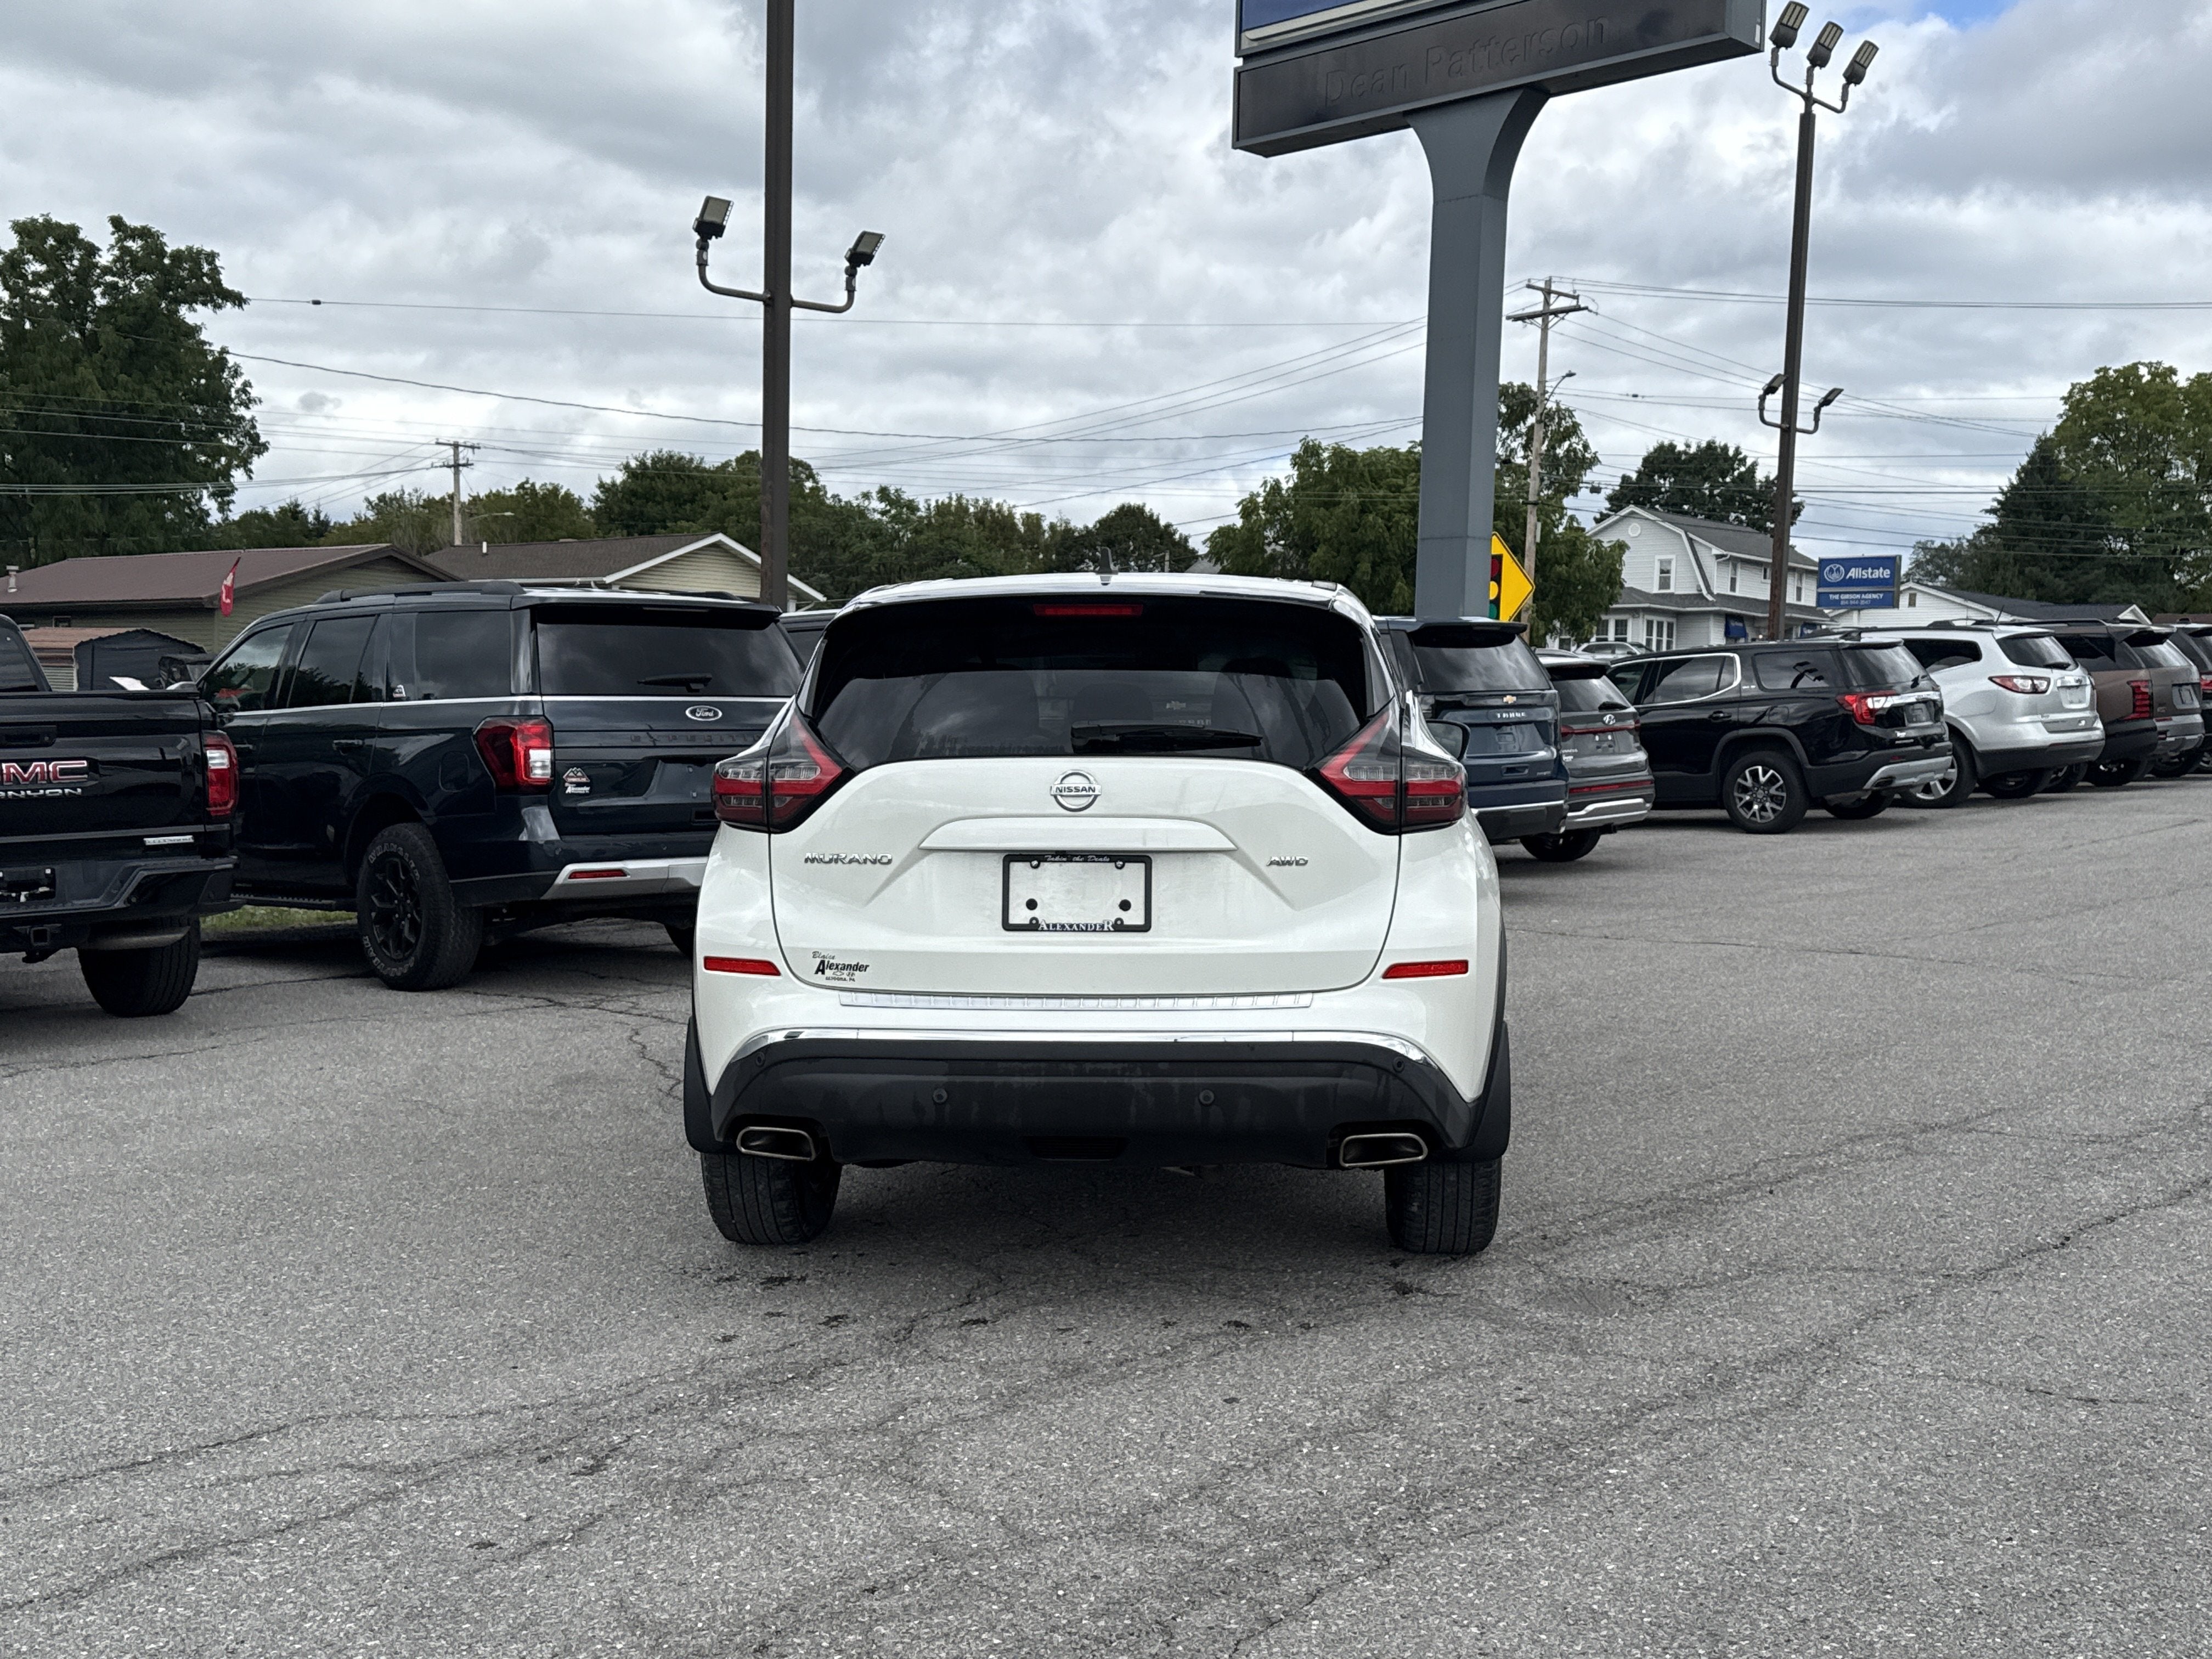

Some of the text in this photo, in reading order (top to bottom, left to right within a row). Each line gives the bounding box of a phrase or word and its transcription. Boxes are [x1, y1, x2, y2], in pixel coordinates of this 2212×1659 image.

[1325, 15, 1609, 107] Dean Patterson
[1846, 567, 1891, 579] Allstate
[0, 760, 88, 785] MC
[804, 852, 893, 865] MURANO
[1266, 855, 1308, 866] AWD
[1038, 919, 1115, 932] ALEXANDER
[814, 960, 870, 975] Alexander
